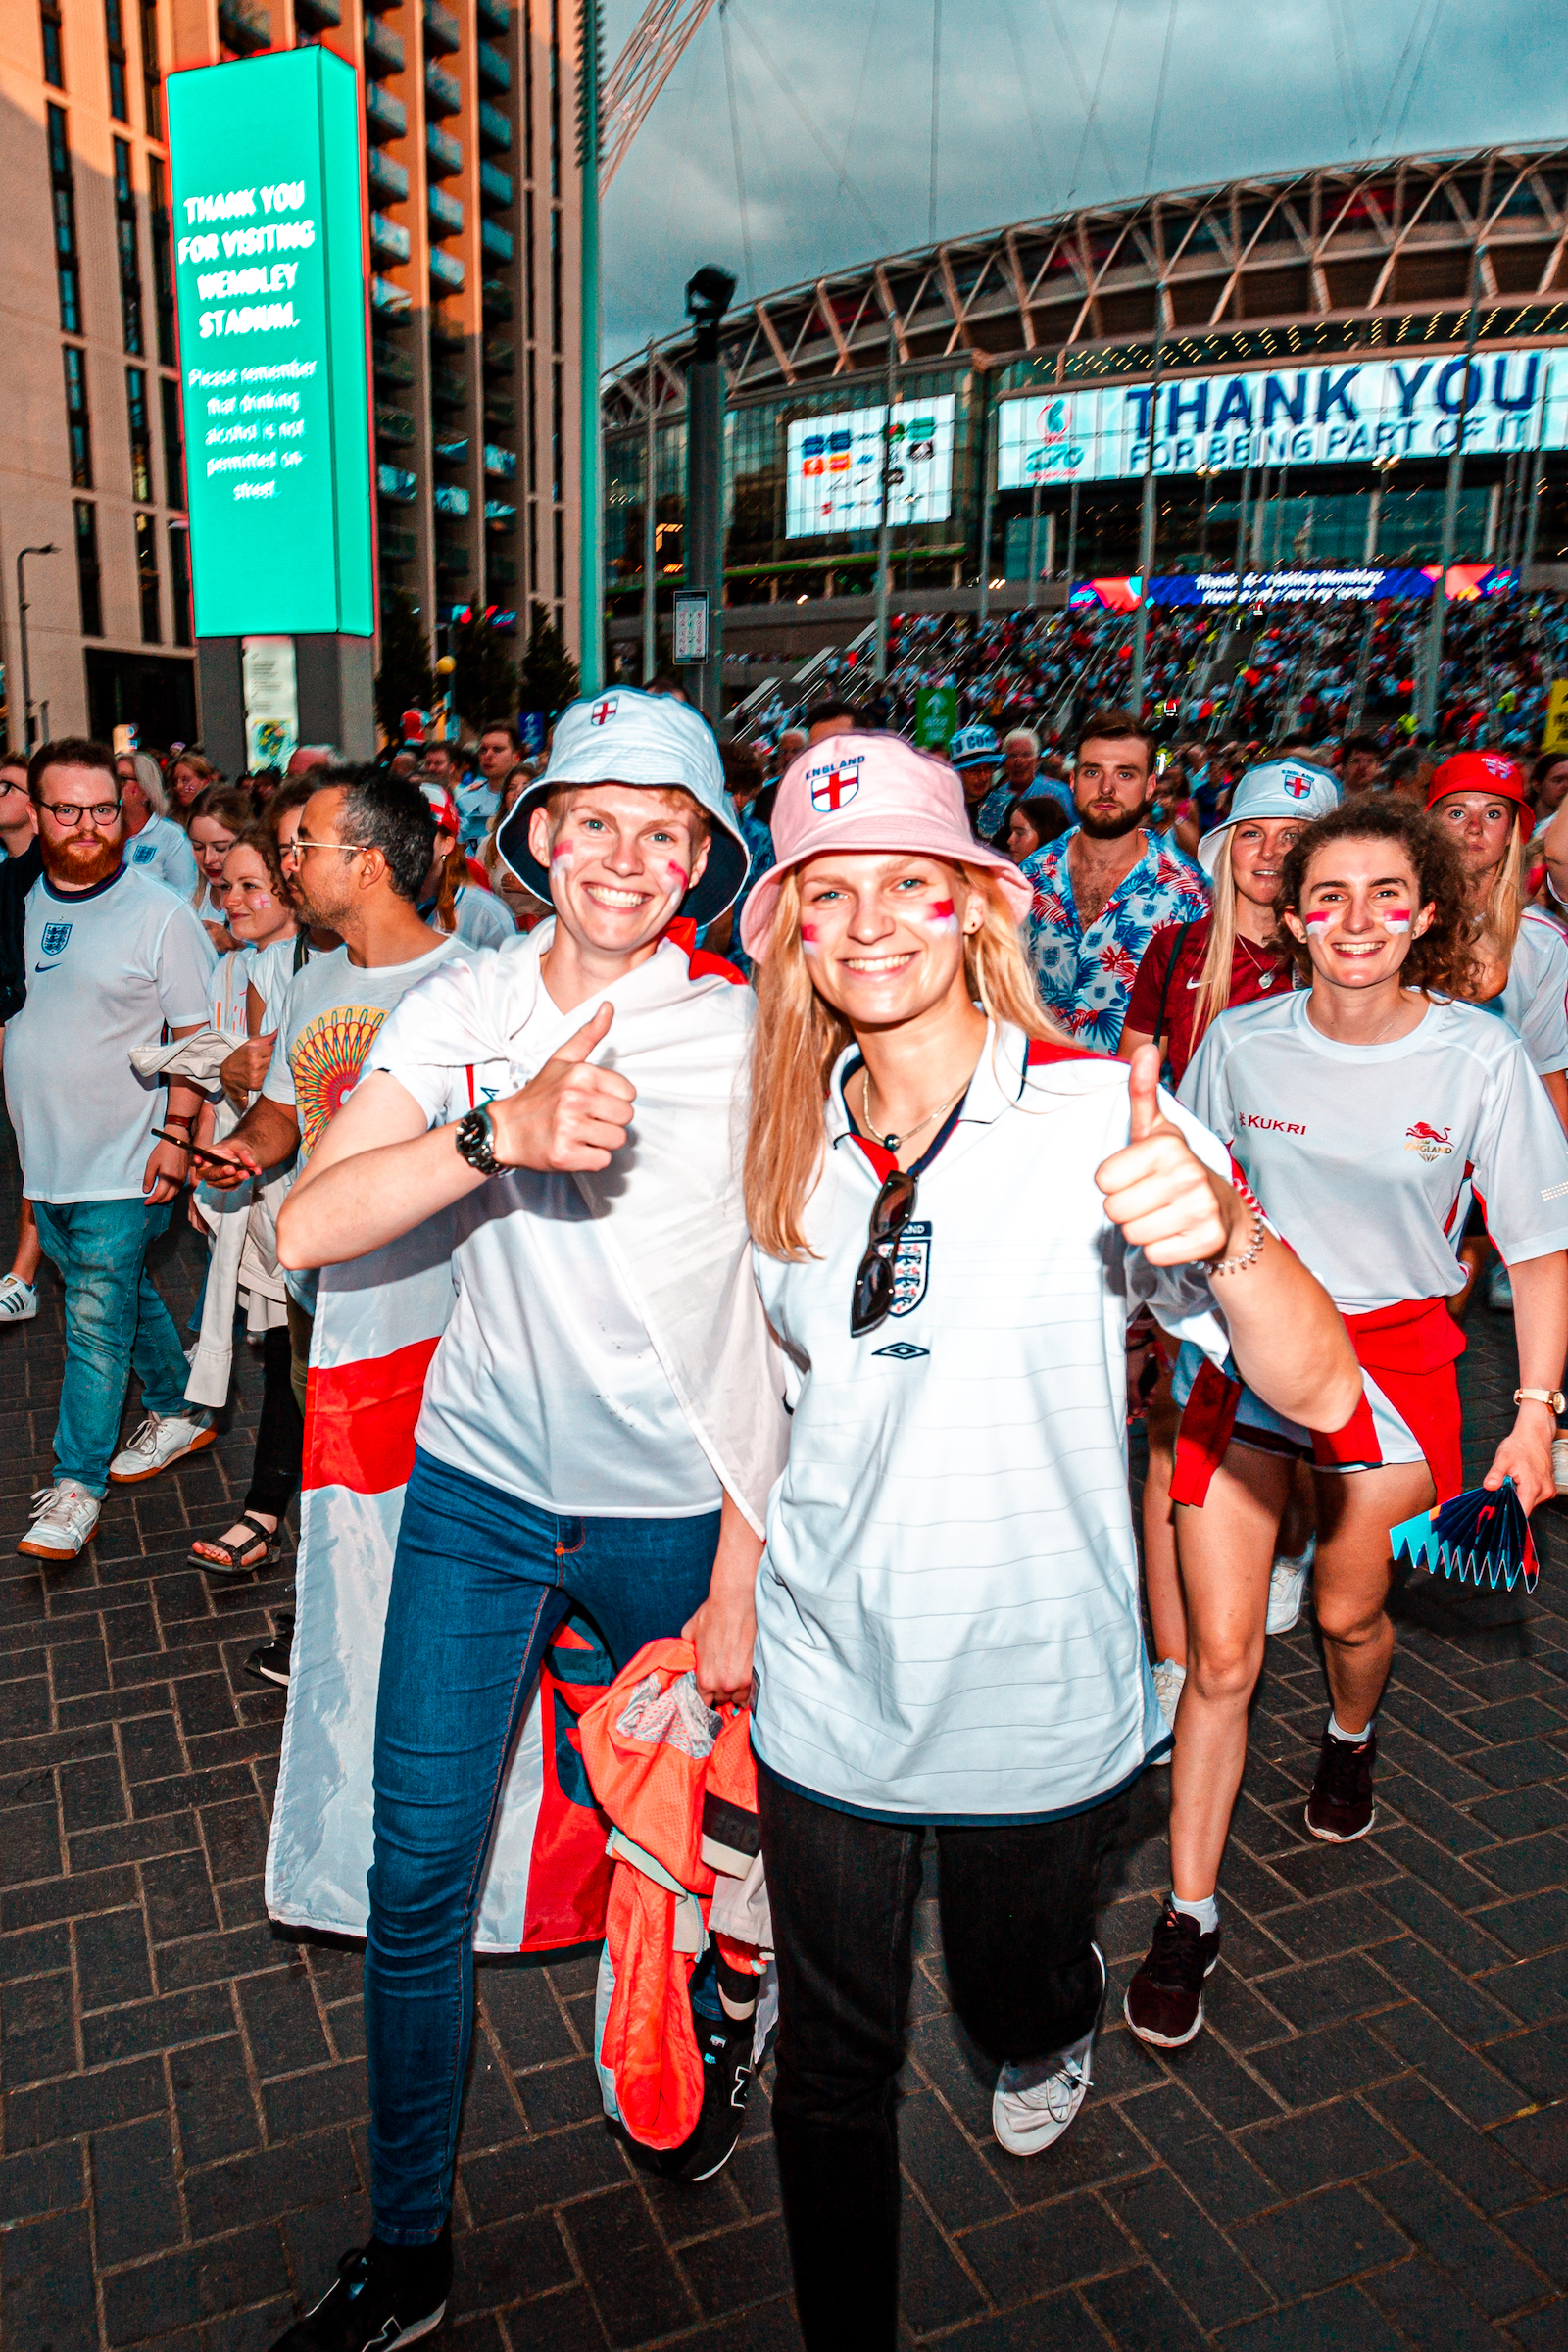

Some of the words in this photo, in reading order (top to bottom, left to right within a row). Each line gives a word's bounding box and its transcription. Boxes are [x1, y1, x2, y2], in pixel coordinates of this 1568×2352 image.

[183, 187, 258, 226] THANK
[260, 179, 306, 216] YOU
[177, 232, 220, 266] FOR
[221, 219, 316, 259] VISITING
[196, 261, 300, 302] WEMBLEY
[188, 367, 239, 391] Please
[240, 356, 318, 386] remember
[207, 394, 237, 417] that
[239, 388, 301, 415] drinking
[1126, 367, 1361, 439] THANK
[1390, 353, 1543, 417] YOU
[205, 418, 260, 447] alcohol
[262, 419, 277, 441] is
[278, 416, 307, 440] not
[1129, 434, 1196, 472] FOR
[1208, 425, 1313, 467] BEING
[1327, 417, 1423, 457] PART
[1435, 412, 1485, 451] OF
[1497, 409, 1532, 447] IT
[206, 446, 278, 480] permitted
[806, 756, 865, 780] ENGLAND
[1248, 1115, 1307, 1135] KUKRI
[1405, 1142, 1452, 1154] ENGLAND
